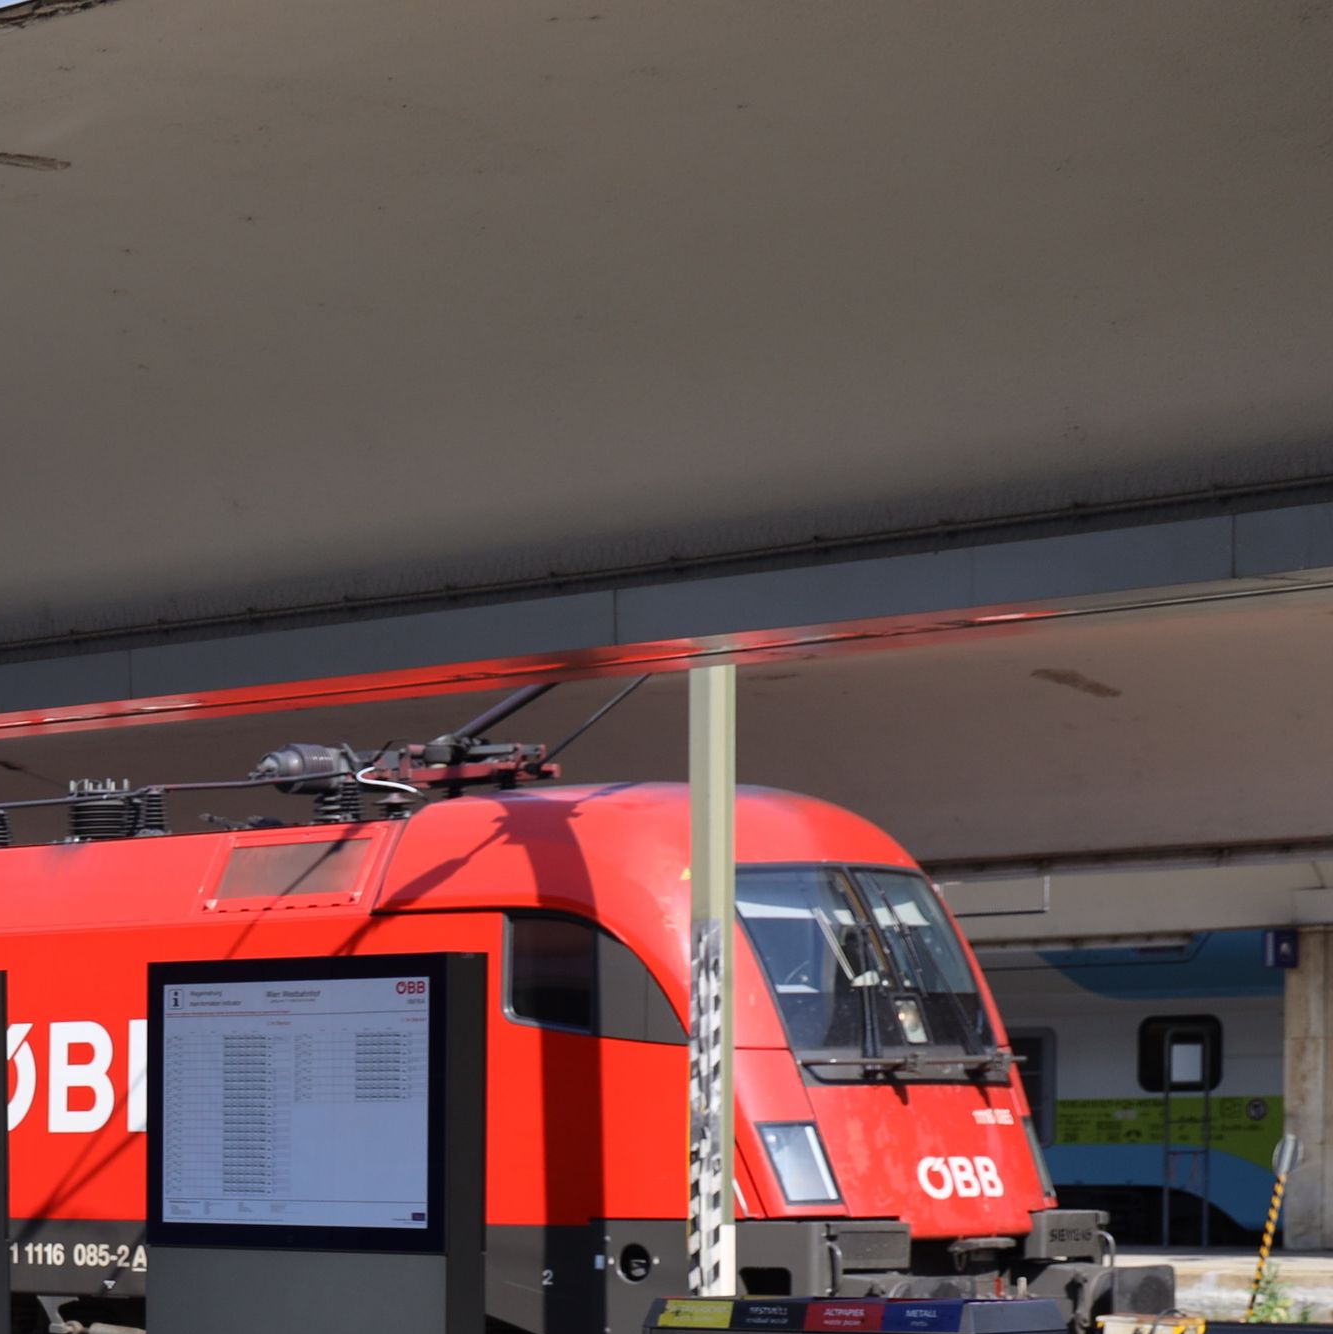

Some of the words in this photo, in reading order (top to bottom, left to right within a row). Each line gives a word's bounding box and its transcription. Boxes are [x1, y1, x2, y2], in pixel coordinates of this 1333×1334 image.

[395, 980, 426, 995] ÖBB
[916, 1156, 1005, 1200] ÖBB
[24, 1242, 65, 1266] 1116
[73, 1243, 131, 1268] 085-2
[541, 1269, 554, 1286] 2
